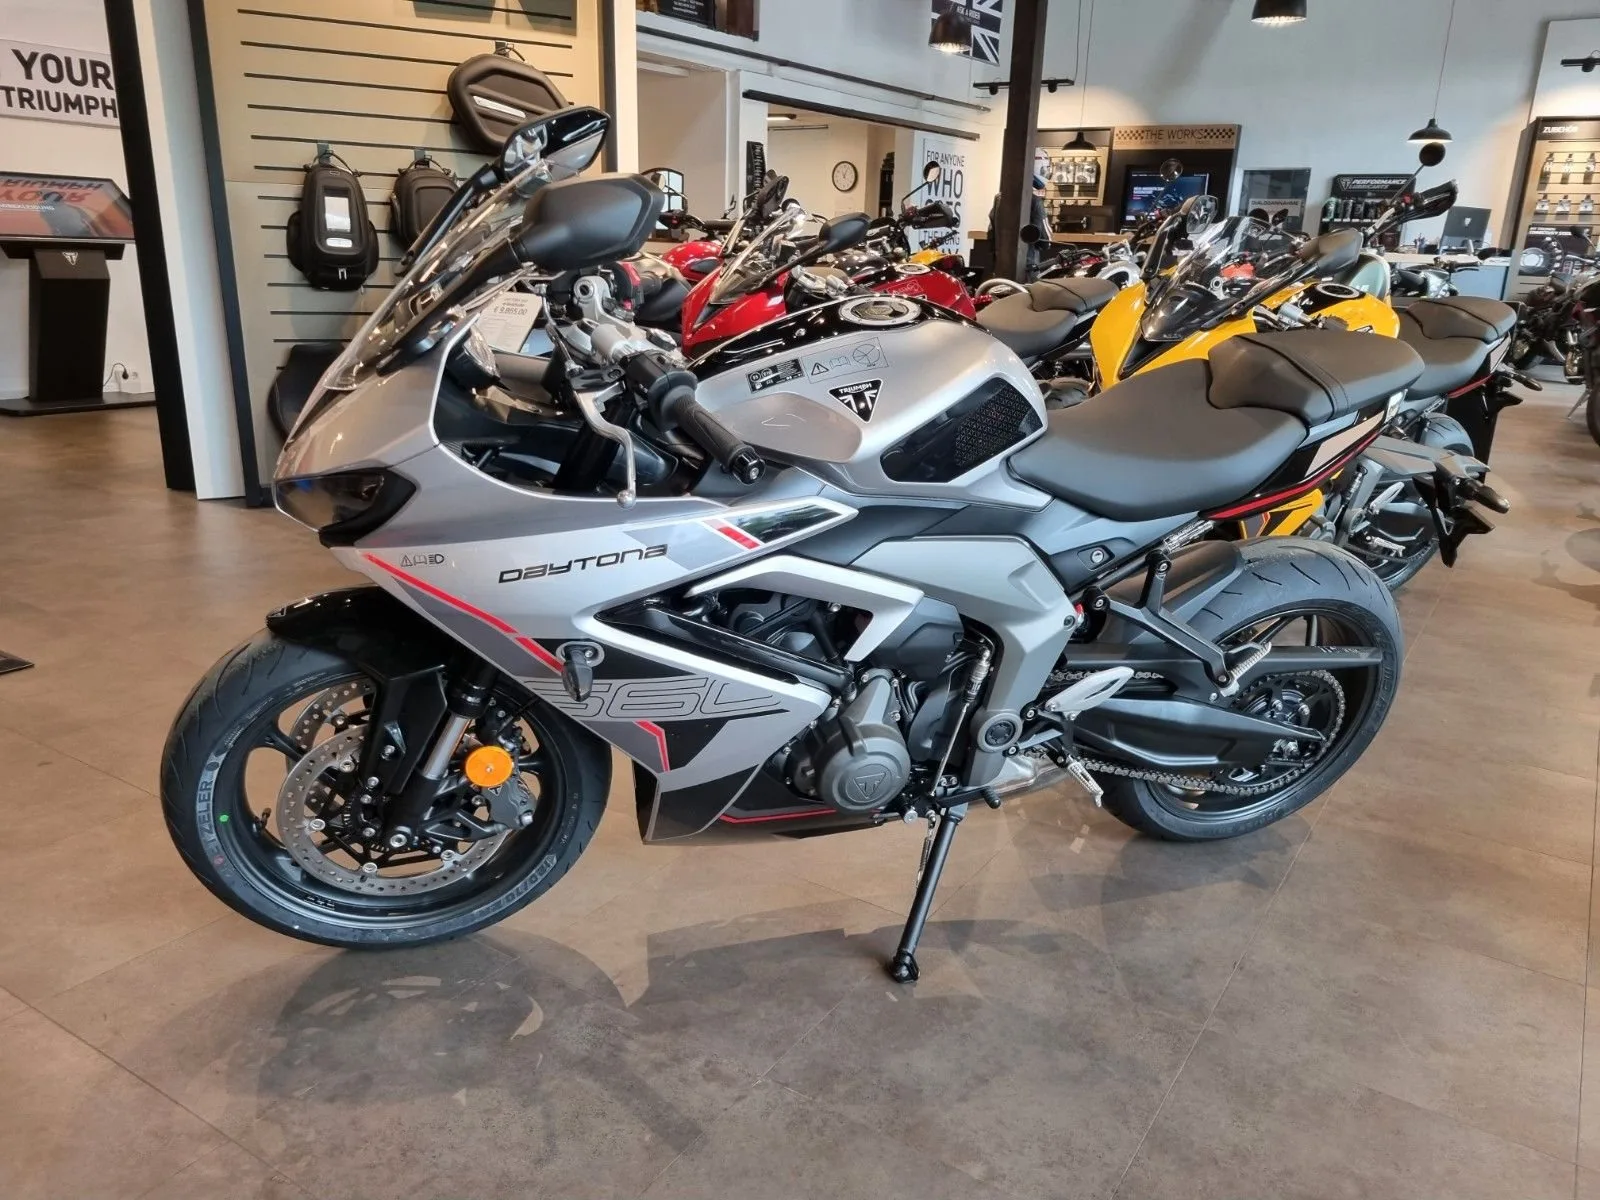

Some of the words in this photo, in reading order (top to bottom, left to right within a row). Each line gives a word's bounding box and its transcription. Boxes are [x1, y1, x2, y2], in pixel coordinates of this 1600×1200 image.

[11, 48, 115, 91] YOUR
[0, 85, 118, 119] TRIUMPH
[1144, 129, 1165, 140] THE
[1167, 128, 1204, 140] WORKS
[926, 150, 940, 162] FOR
[940, 153, 966, 168] ANYONE
[925, 165, 964, 199] WHO
[838, 382, 872, 395] TRIUMPH
[498, 543, 668, 584] DAYTONA
